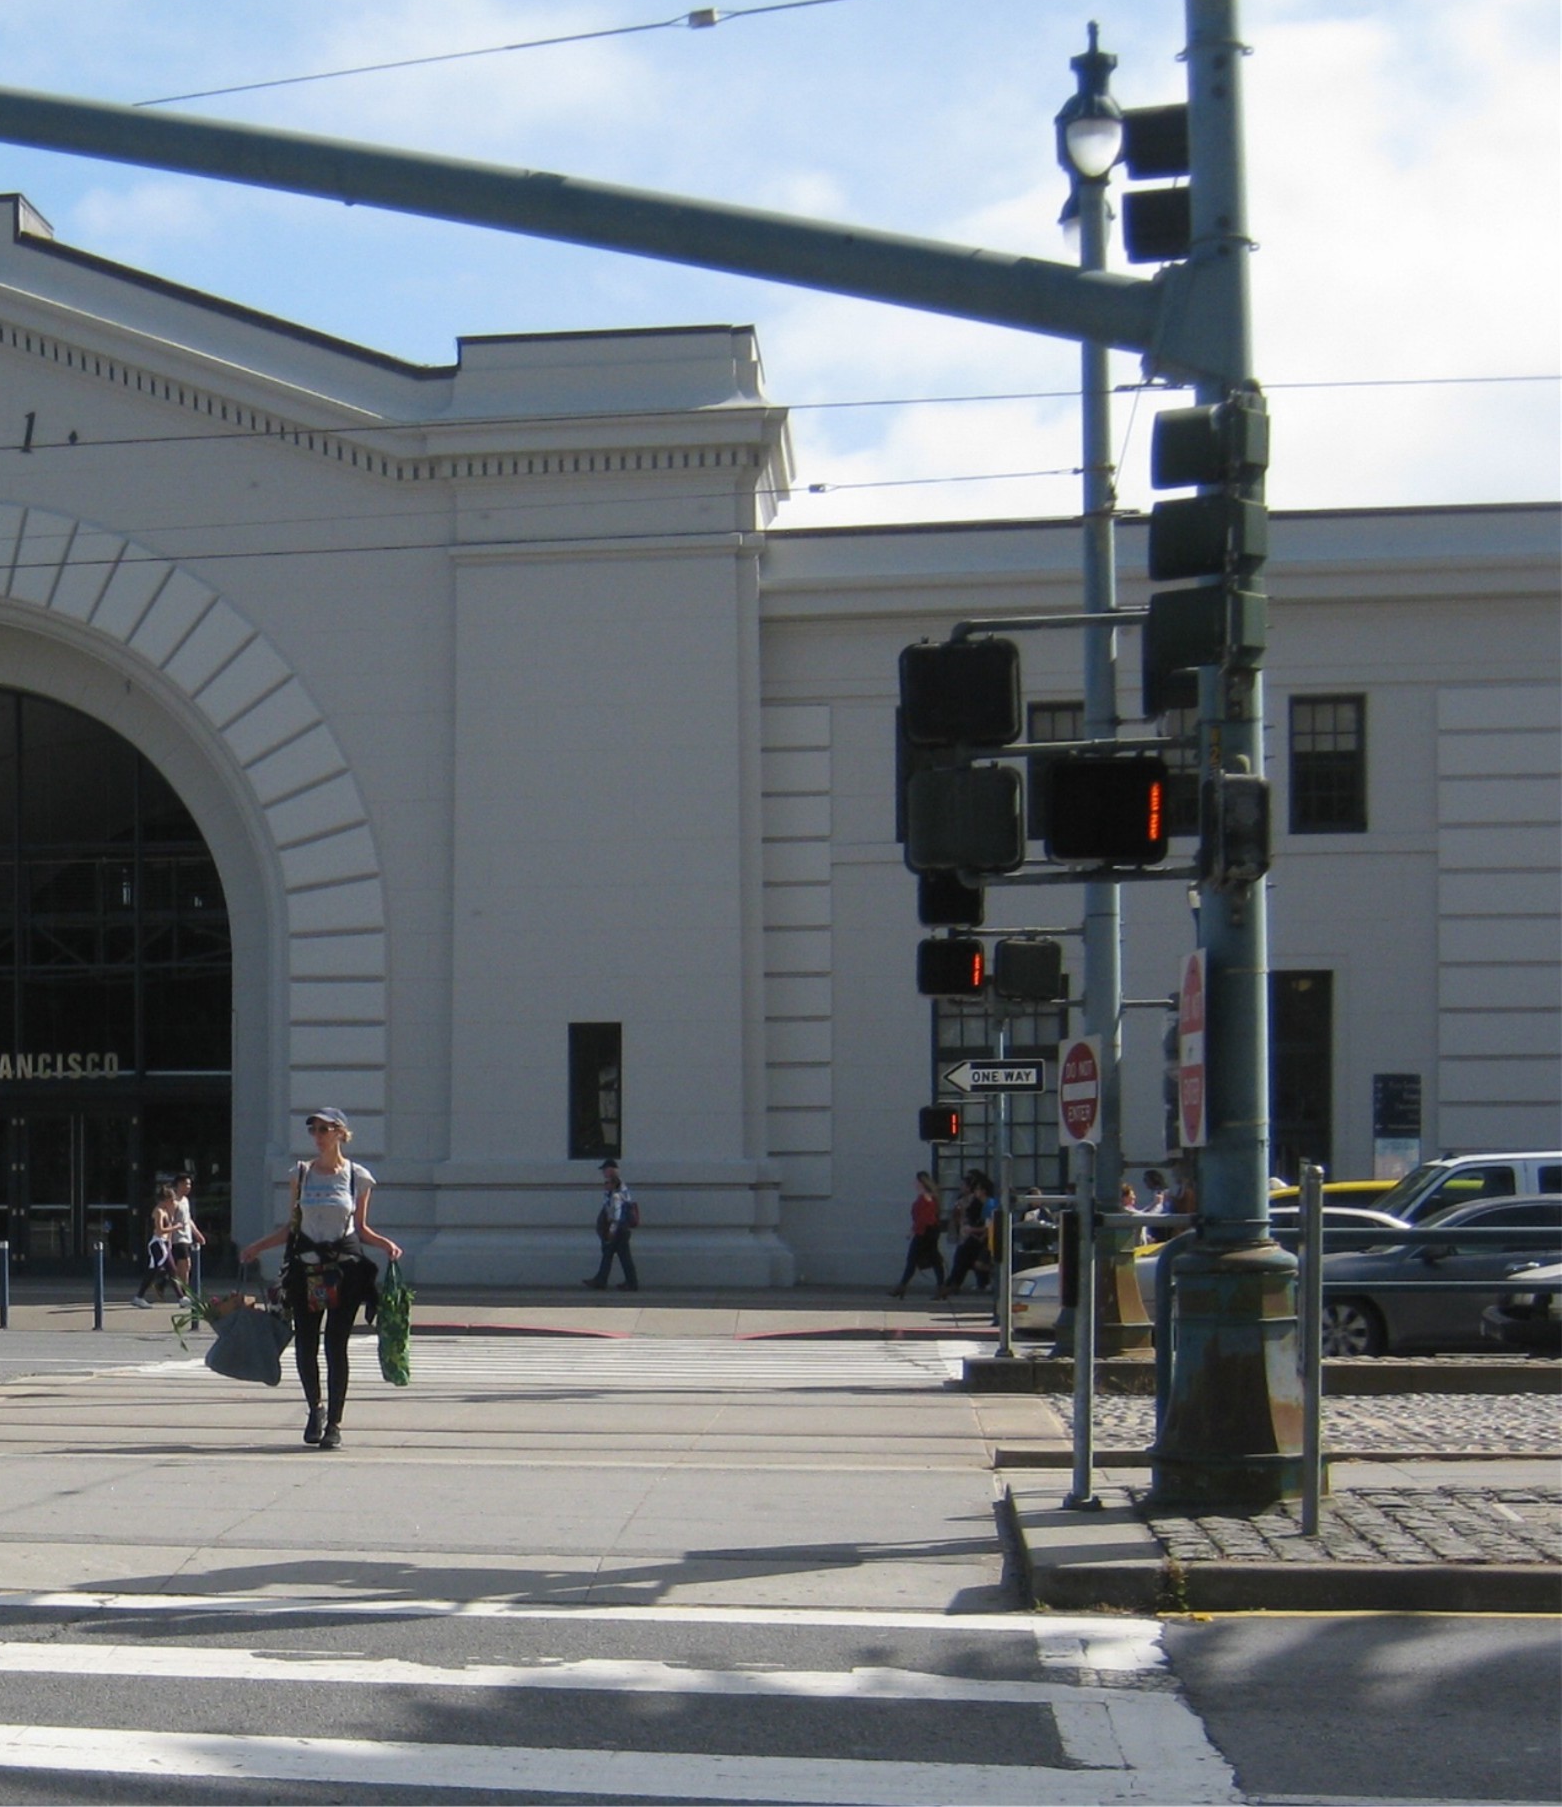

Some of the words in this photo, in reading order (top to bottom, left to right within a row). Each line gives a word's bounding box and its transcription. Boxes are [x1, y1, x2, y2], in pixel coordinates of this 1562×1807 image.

[20, 411, 36, 453] 1
[971, 1070, 999, 1083] ONE
[1004, 1070, 1033, 1082] WAY
[1067, 1104, 1091, 1123] ENTER
